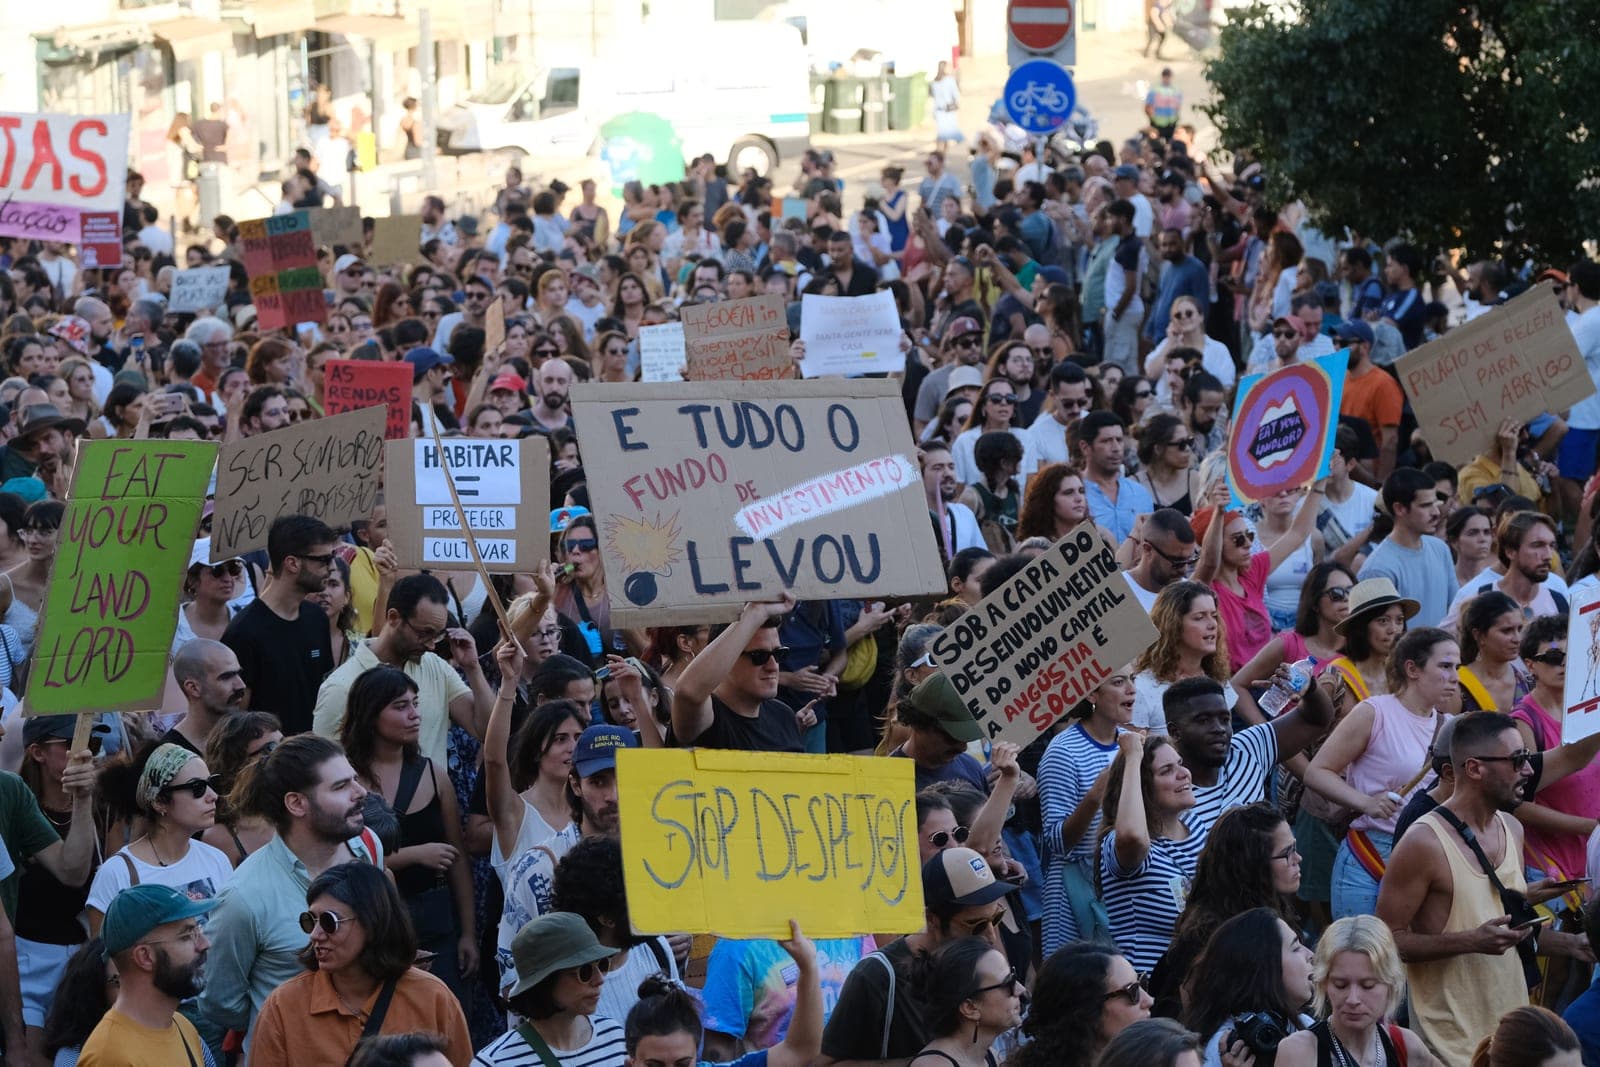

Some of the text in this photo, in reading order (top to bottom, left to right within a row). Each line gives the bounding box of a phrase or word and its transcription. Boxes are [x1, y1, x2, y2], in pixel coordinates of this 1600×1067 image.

[760, 305, 778, 321] in
[844, 328, 871, 339] GENTE
[329, 365, 354, 383] AS
[841, 343, 864, 351] CASA
[1474, 338, 1498, 359] DE
[1476, 353, 1521, 387] PARA
[328, 384, 401, 403] RENDAS
[1439, 353, 1573, 445] SEM ABRIGO
[610, 401, 860, 452] E TUDO O
[1255, 427, 1303, 456] LANDLORD
[1258, 421, 1277, 441] EAT
[101, 448, 187, 501] EAT
[228, 444, 283, 496] SER
[623, 452, 728, 512] FUNDO
[734, 479, 761, 502] DE
[743, 455, 904, 534] INVESTIMENTO
[69, 502, 168, 580] YOUR
[216, 494, 267, 553] NÃO
[686, 532, 881, 595] LEVOU
[70, 568, 151, 621] LAND
[932, 530, 1094, 665] SOB A CAPA DO
[951, 547, 1120, 696] DESENVOLVIMENTO
[43, 626, 135, 688] LORD
[967, 586, 1126, 721] E DO NOVO CAPITAL
[987, 625, 1109, 740] A ANGÚSTIA É
[1028, 659, 1113, 732] SOCIAL
[642, 779, 739, 890] STOP
[749, 786, 911, 906] DESPEJOS
